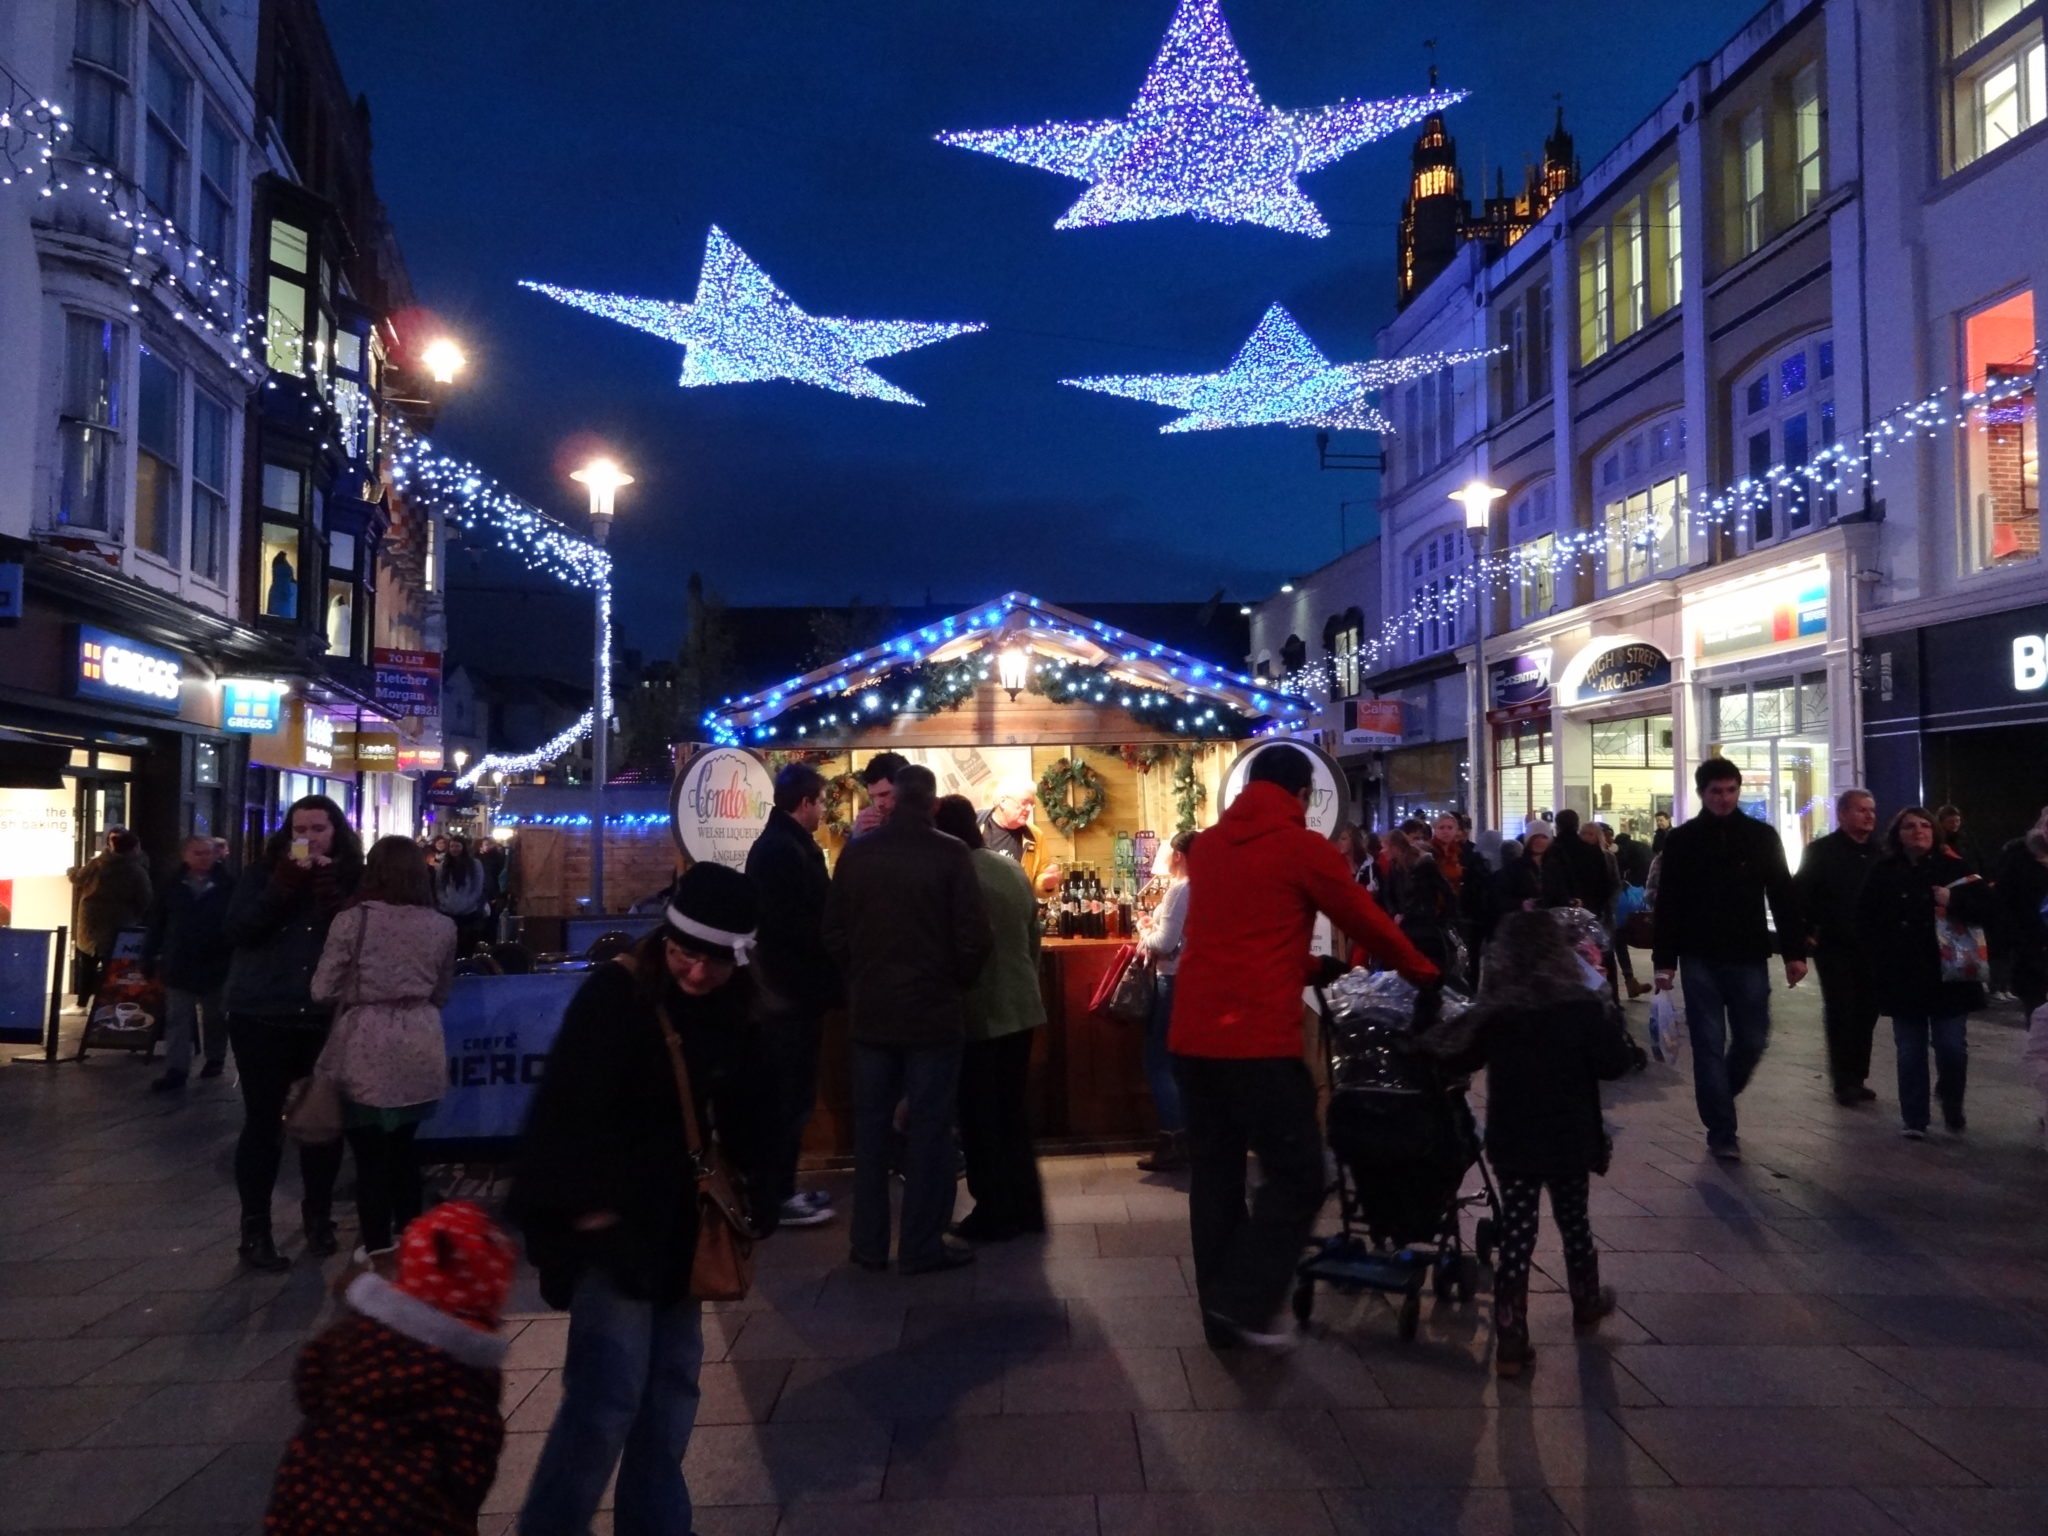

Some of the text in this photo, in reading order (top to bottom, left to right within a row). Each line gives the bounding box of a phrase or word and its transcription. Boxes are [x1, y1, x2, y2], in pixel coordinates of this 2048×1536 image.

[389, 653, 425, 665] TO LET
[1586, 647, 1661, 684] HIGH STREET
[2013, 634, 2048, 691] B
[376, 671, 428, 686] Fletcher
[1598, 668, 1645, 692] ARCADE
[376, 687, 425, 701] Morgan
[227, 716, 272, 730] GREGGS
[359, 743, 396, 754] Leeds
[46, 807, 67, 818] the
[22, 821, 67, 832] baking
[698, 826, 763, 841] WELSH LIQUEUR
[450, 1053, 547, 1087] ERO
